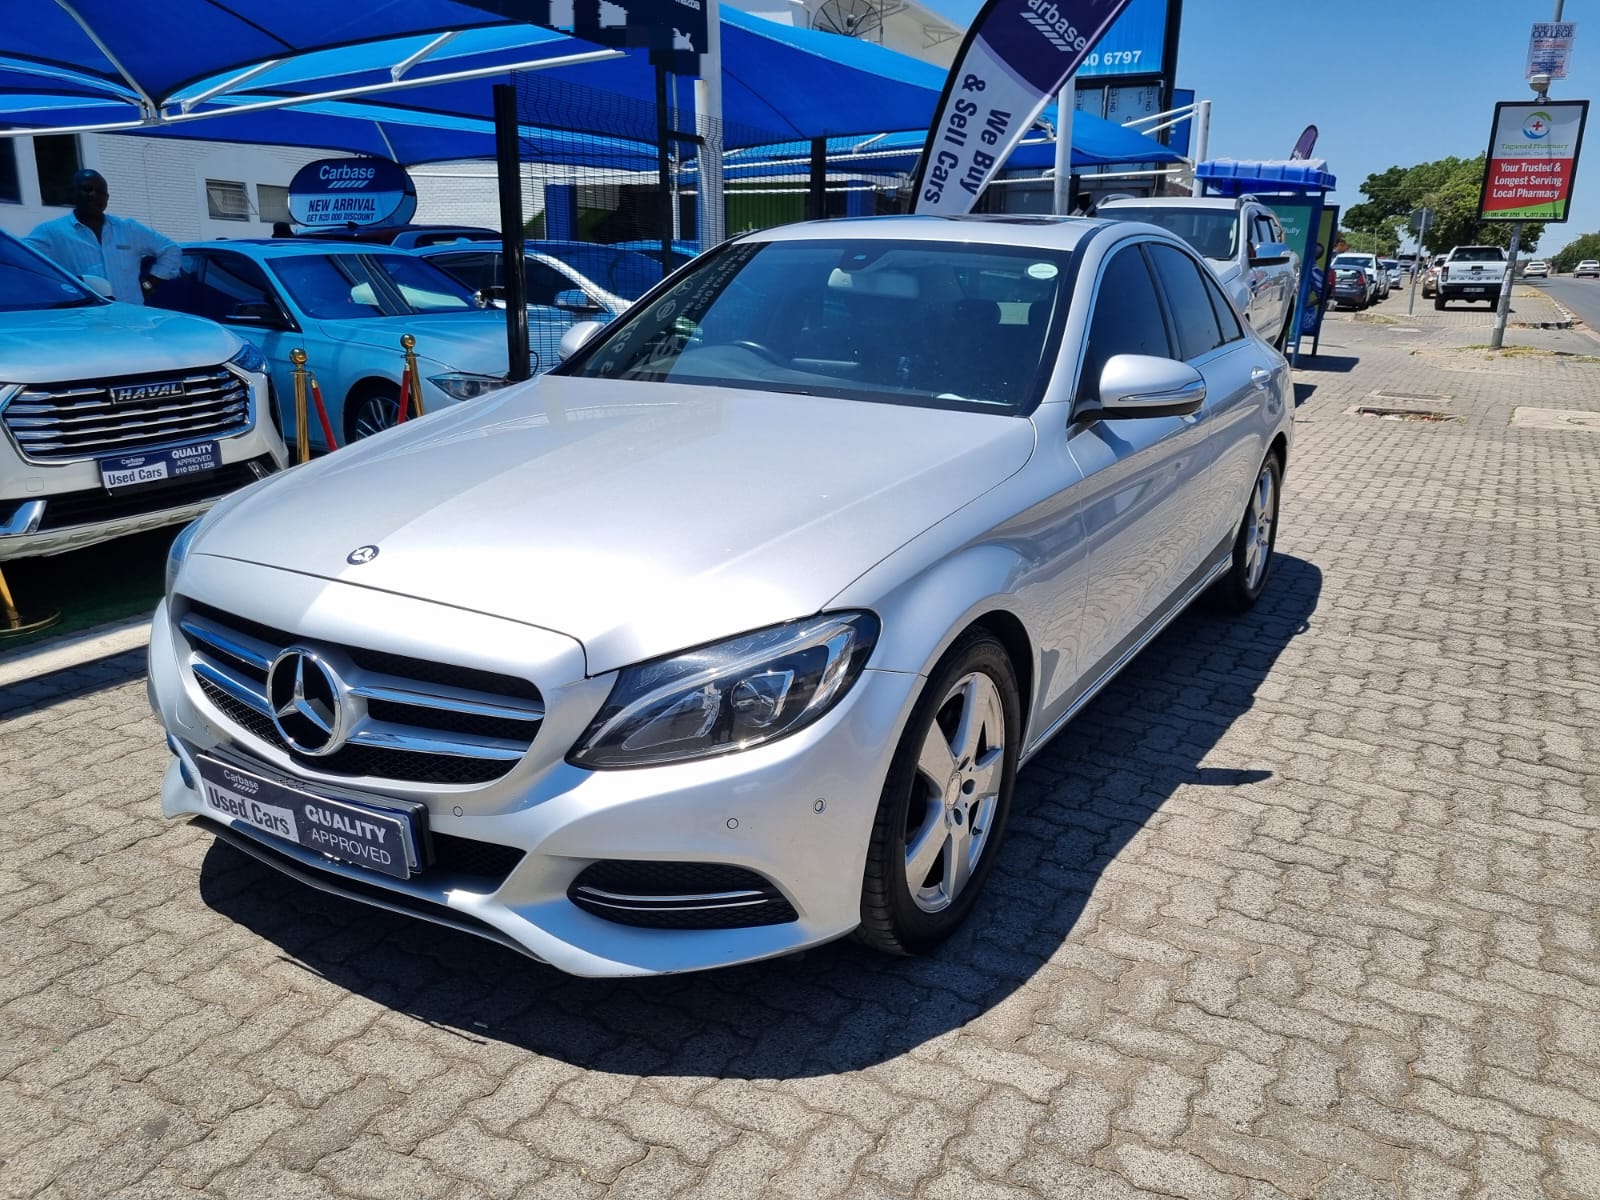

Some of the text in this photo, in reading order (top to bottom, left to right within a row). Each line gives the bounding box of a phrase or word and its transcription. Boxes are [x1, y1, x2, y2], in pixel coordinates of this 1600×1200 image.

[1532, 30, 1573, 38] COLLEGE
[1103, 50, 1142, 66] 6797
[924, 74, 986, 204] & Sell Cars
[960, 109, 1012, 196] We Buy
[319, 164, 376, 180] Carbase
[1501, 162, 1561, 172] Your Trusted &
[1494, 175, 1563, 187] Longest Serving
[1492, 188, 1560, 199] Local Pharmacy
[308, 198, 376, 213] NEW ARRIVAL
[306, 213, 317, 222] GET
[343, 212, 375, 221] DISCOUNT
[118, 384, 182, 400] HAVAL
[171, 444, 213, 459] QUALITY
[121, 457, 146, 465] Carbase
[176, 454, 212, 466] APPROVED
[108, 466, 162, 486] Used Cars
[175, 466, 187, 475] 010
[223, 769, 260, 790] Carbase
[208, 786, 290, 836] Used Cars
[305, 804, 386, 844] QUALITY
[311, 828, 391, 865] APPROVED
